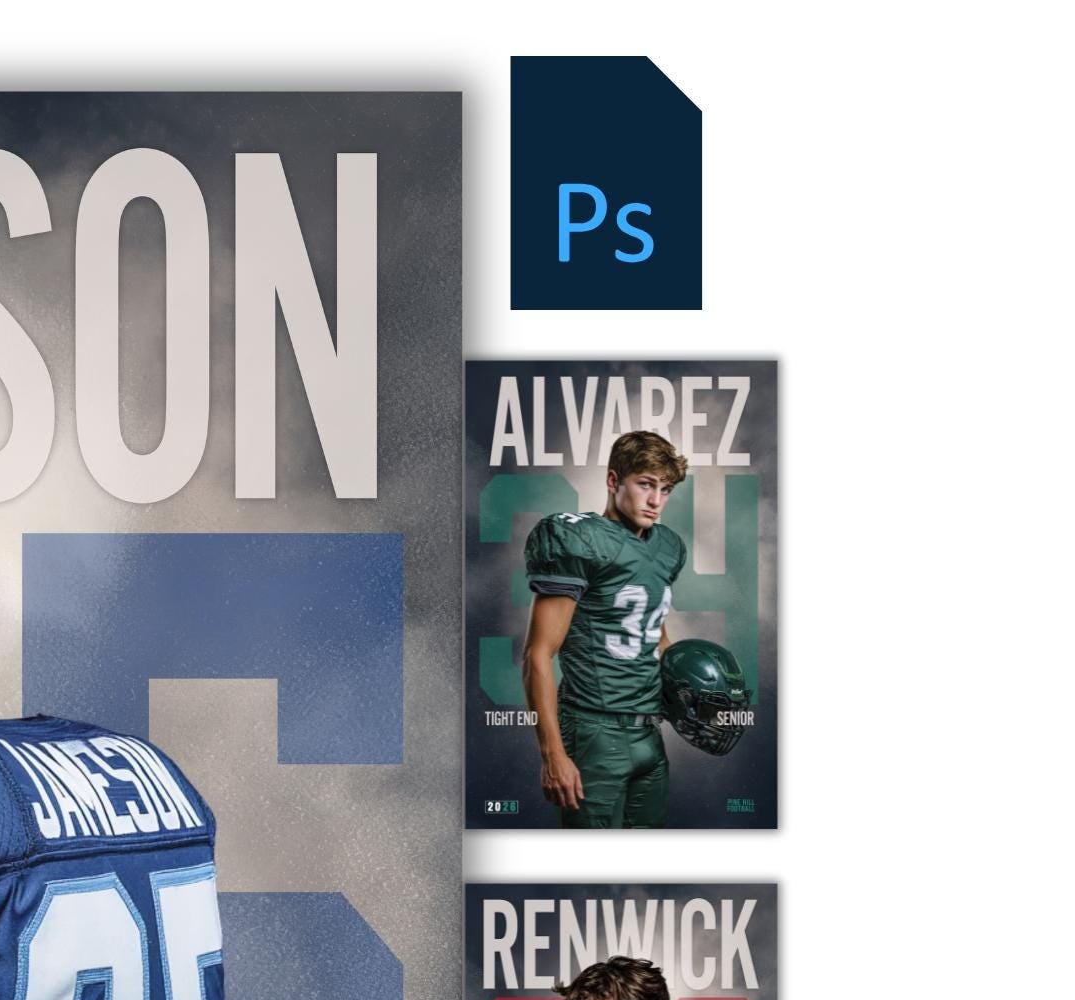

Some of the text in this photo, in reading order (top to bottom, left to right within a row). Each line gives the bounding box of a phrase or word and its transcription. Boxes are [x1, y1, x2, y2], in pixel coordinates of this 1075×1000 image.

[558, 183, 655, 264] Ps
[489, 376, 751, 466] ALVAREZ
[485, 711, 538, 726] TIGHT END
[716, 711, 754, 726] SENIOR
[482, 898, 760, 990] RENWICK
